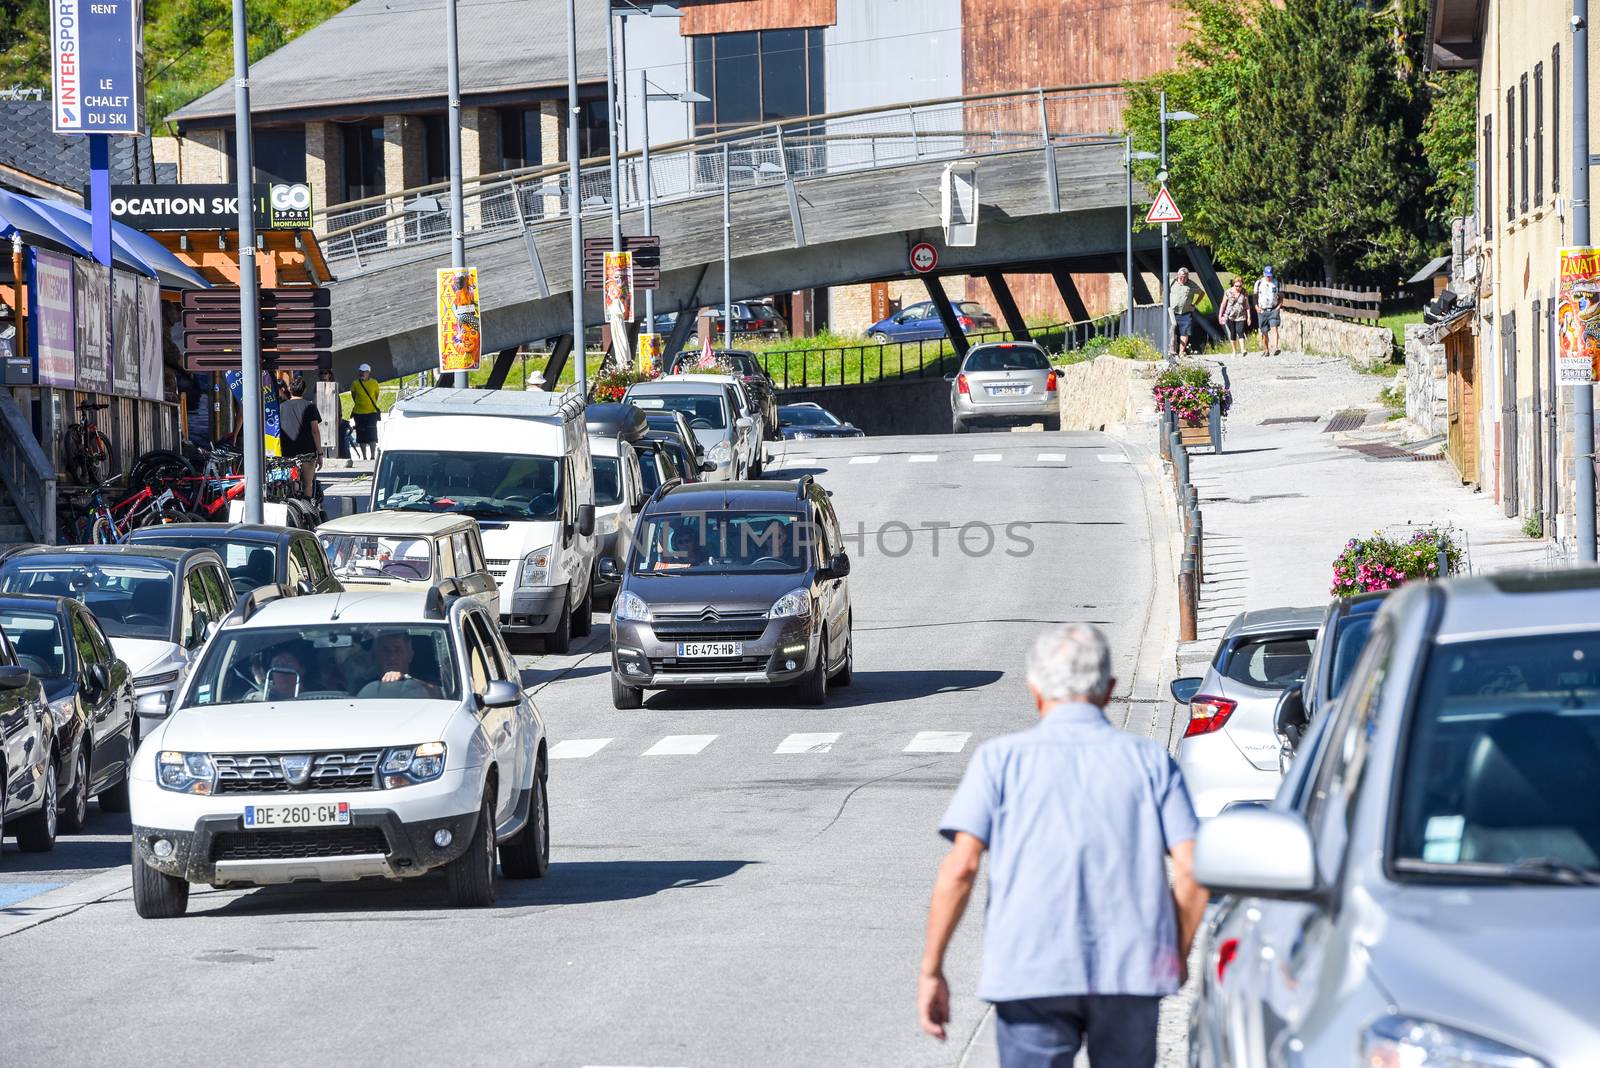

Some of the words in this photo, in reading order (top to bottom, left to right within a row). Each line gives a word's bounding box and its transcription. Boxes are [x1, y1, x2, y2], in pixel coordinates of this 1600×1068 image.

[91, 4, 118, 14] RENT
[100, 79, 113, 90] LE
[84, 96, 129, 107] CHALET
[88, 113, 105, 124] DU
[109, 113, 127, 124] SKI
[271, 184, 310, 211] GO
[111, 198, 205, 215] OCATION
[1562, 254, 1600, 276] ZAVATT
